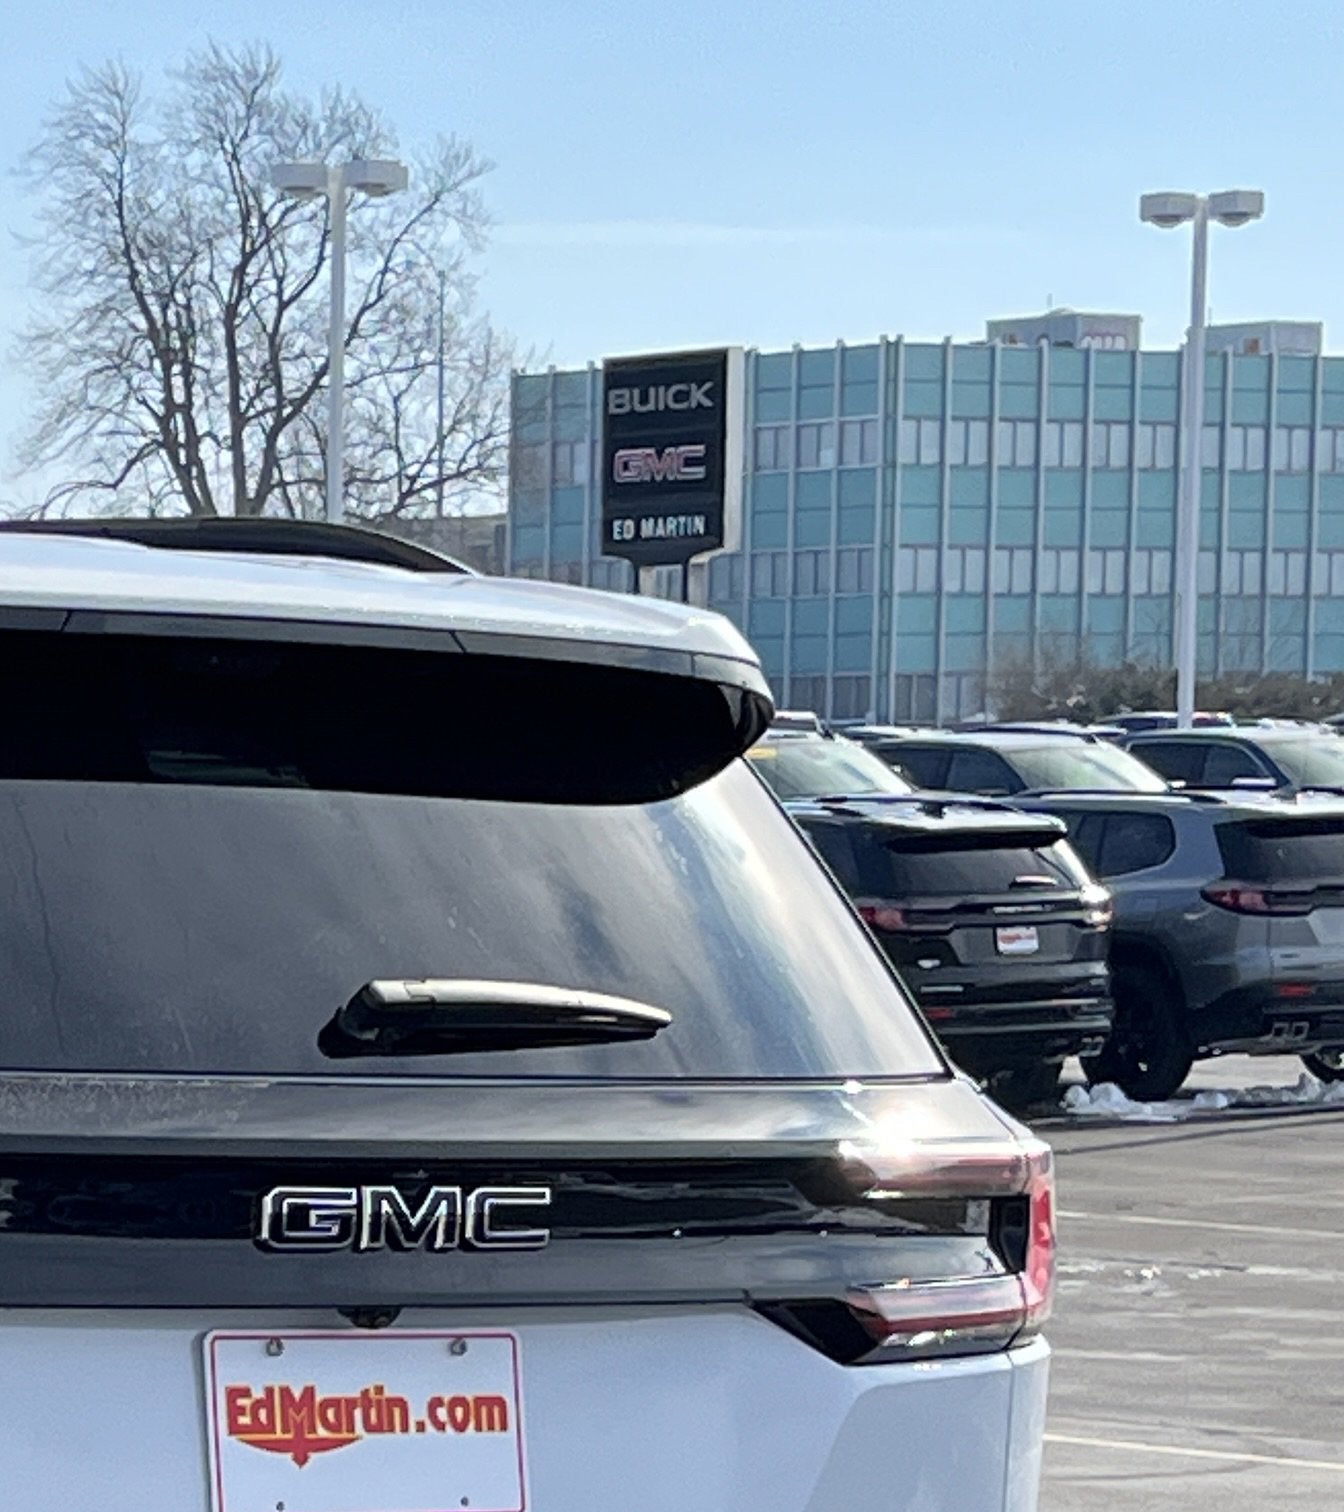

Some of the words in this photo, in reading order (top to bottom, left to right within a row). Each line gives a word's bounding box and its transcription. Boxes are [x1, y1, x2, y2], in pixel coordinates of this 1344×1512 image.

[608, 381, 715, 415] BUICK
[613, 444, 706, 483] GMC
[612, 518, 635, 541] ED
[640, 514, 706, 540] MARTIN
[260, 1185, 552, 1251] GMC
[224, 1384, 509, 1436] EdMartin.com
